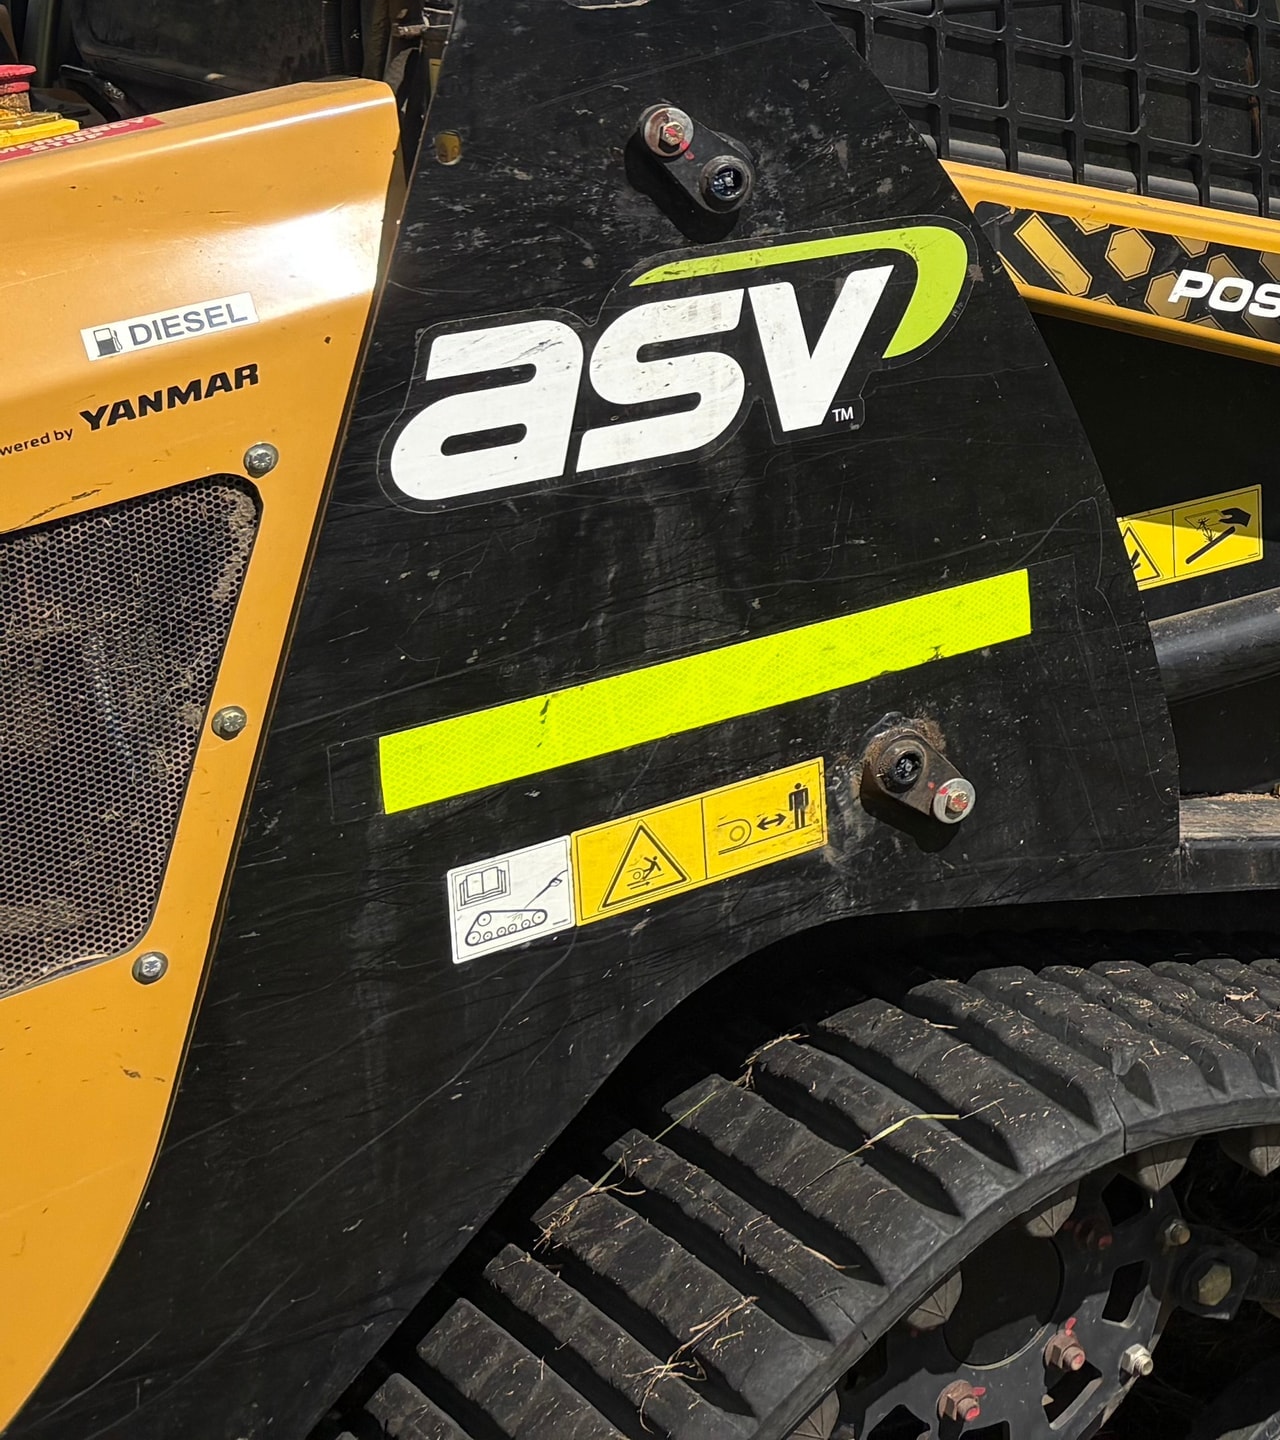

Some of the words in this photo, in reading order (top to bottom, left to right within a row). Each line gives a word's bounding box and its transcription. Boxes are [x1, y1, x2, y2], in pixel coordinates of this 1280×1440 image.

[29, 132, 104, 152] STOP
[128, 303, 248, 346] DIESEL
[54, 428, 74, 442] by
[79, 363, 259, 431] YANMAR
